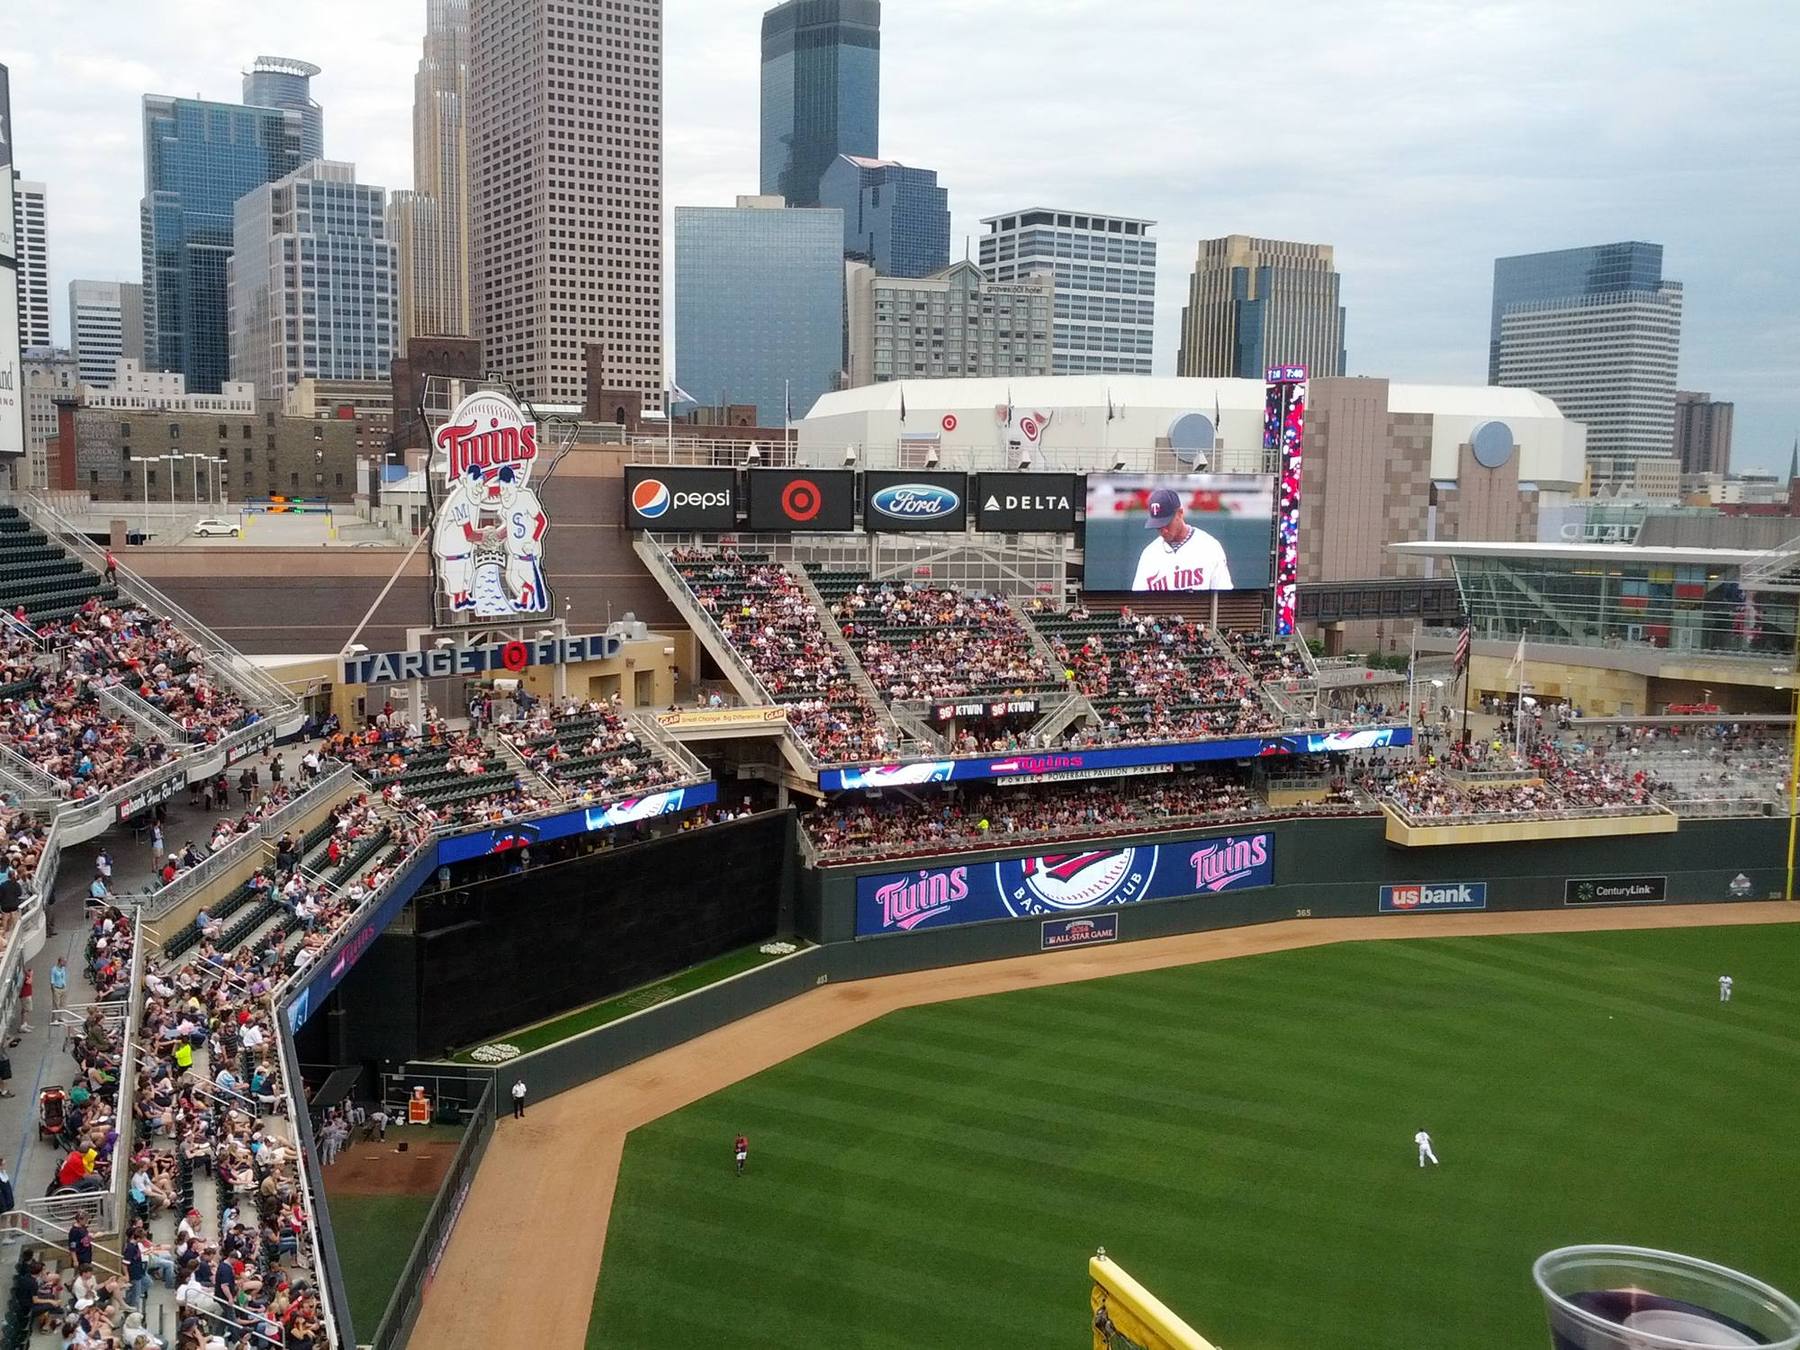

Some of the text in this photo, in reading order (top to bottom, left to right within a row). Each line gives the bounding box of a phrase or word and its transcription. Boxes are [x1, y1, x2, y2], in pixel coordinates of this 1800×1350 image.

[437, 417, 537, 482] Twins
[673, 489, 730, 510] pepsi
[889, 488, 942, 513] Ford
[1005, 496, 1070, 510] DELTA
[1151, 502, 1161, 516] T
[344, 635, 623, 683] TARGET FIELD
[955, 703, 983, 716] KTWIN
[1007, 701, 1035, 713] KTWIN
[766, 710, 784, 721] GLAD
[1004, 755, 1083, 772] Twins
[1047, 769, 1092, 781] POWERBALL
[1093, 767, 1128, 777] PAVILION
[1189, 834, 1267, 889] Twins
[875, 866, 969, 928] Twins
[1392, 884, 1473, 906] usbank
[1596, 884, 1652, 897] CenturyLink
[1295, 909, 1312, 917] 365
[1055, 929, 1114, 944] ALL-STAR GAME
